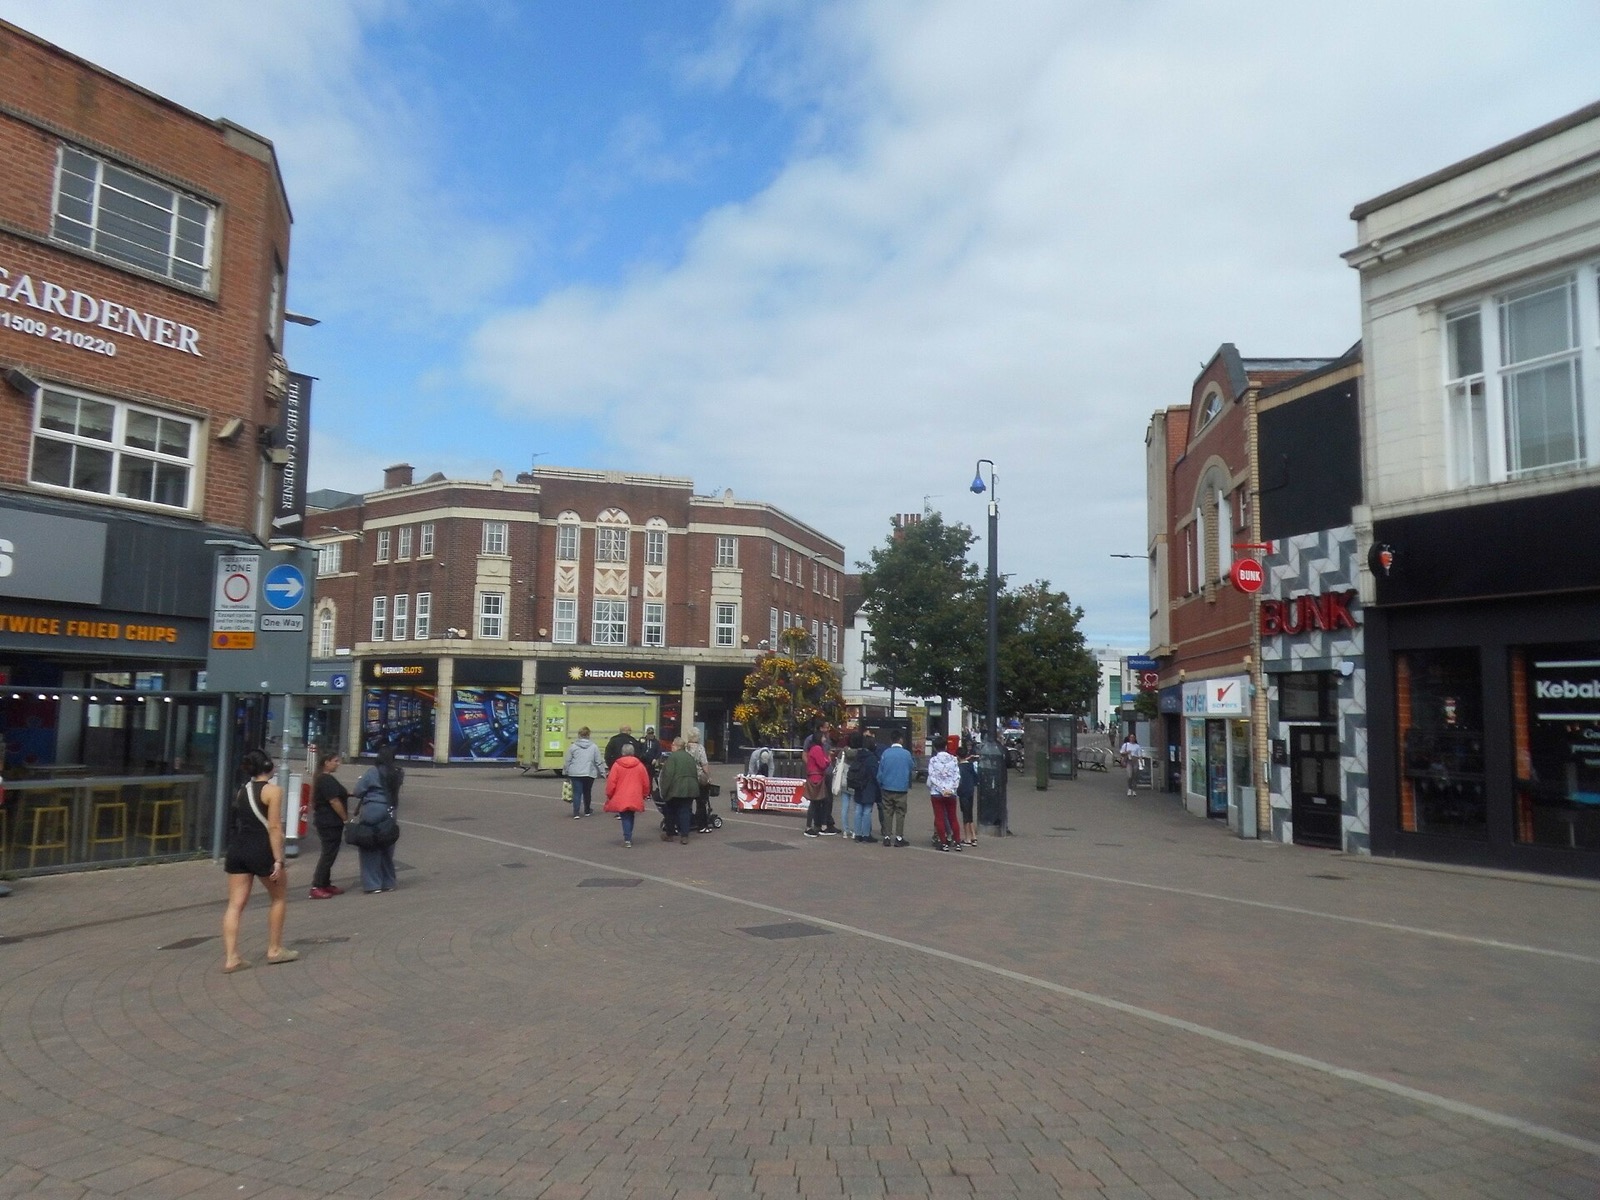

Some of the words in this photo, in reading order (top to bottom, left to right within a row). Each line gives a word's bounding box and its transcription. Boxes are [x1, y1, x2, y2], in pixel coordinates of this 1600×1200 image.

[50, 326, 116, 357] 210220
[287, 382, 299, 407] THE
[286, 408, 299, 442] HEAD
[225, 564, 251, 572] ZONE
[1239, 569, 1261, 581] BUNK
[1260, 589, 1359, 636] BUNK
[0, 614, 60, 635] TWICE
[66, 620, 120, 640] FRIED
[124, 624, 178, 643] CHIPS
[263, 618, 280, 626] One
[282, 618, 300, 628] Way
[584, 669, 624, 678] MERKUR
[624, 671, 655, 679] SLOTS
[765, 786, 796, 795] MARXIST
[766, 794, 794, 802] SOCIETY
